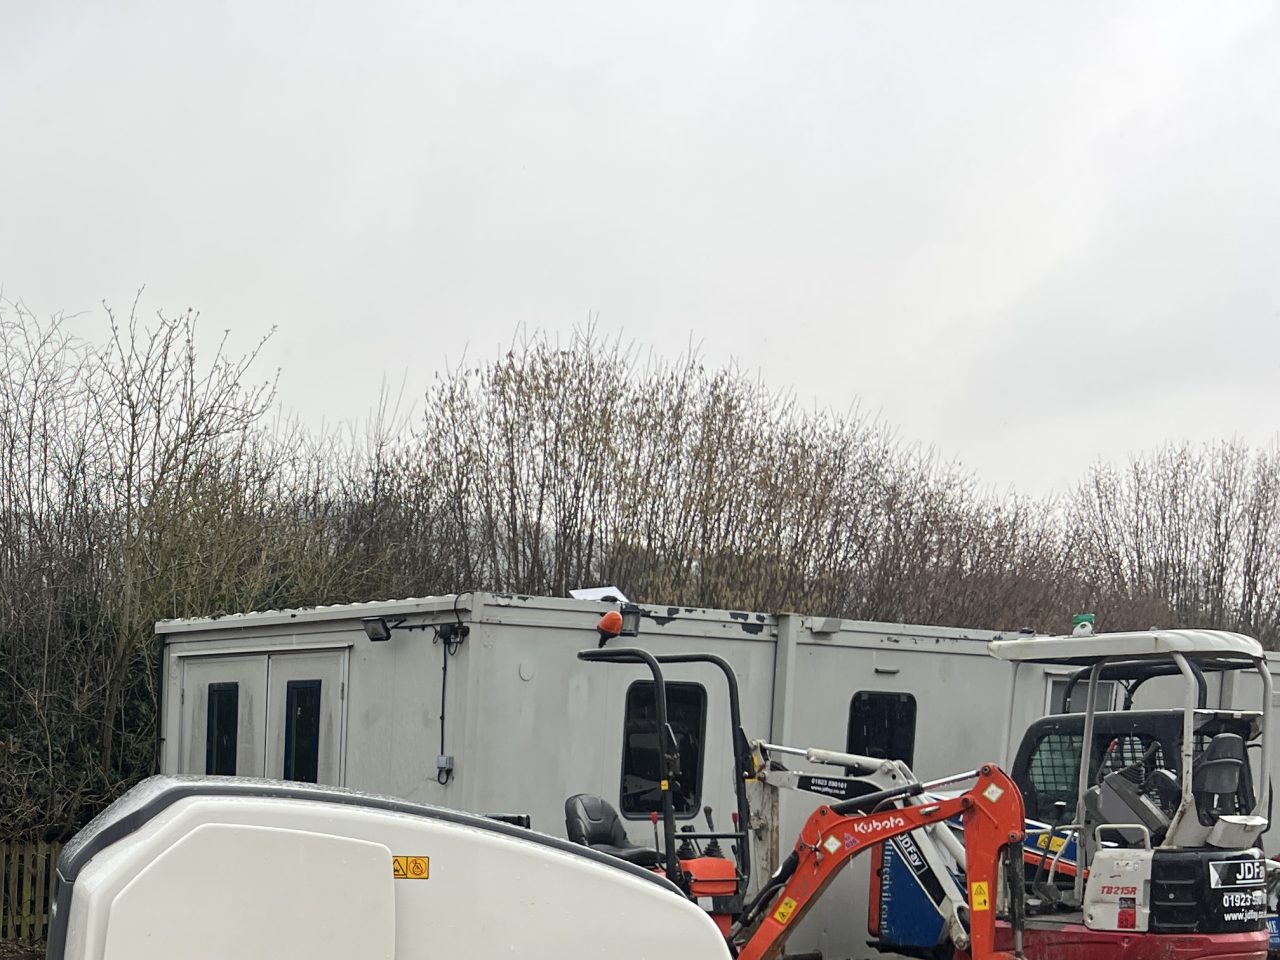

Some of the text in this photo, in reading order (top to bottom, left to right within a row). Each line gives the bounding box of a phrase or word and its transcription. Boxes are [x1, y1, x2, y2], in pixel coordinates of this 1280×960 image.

[854, 816, 905, 834] Kubota
[898, 833, 922, 867] JDFay
[1100, 886, 1137, 895] TB215R
[1223, 894, 1251, 907] 01923
